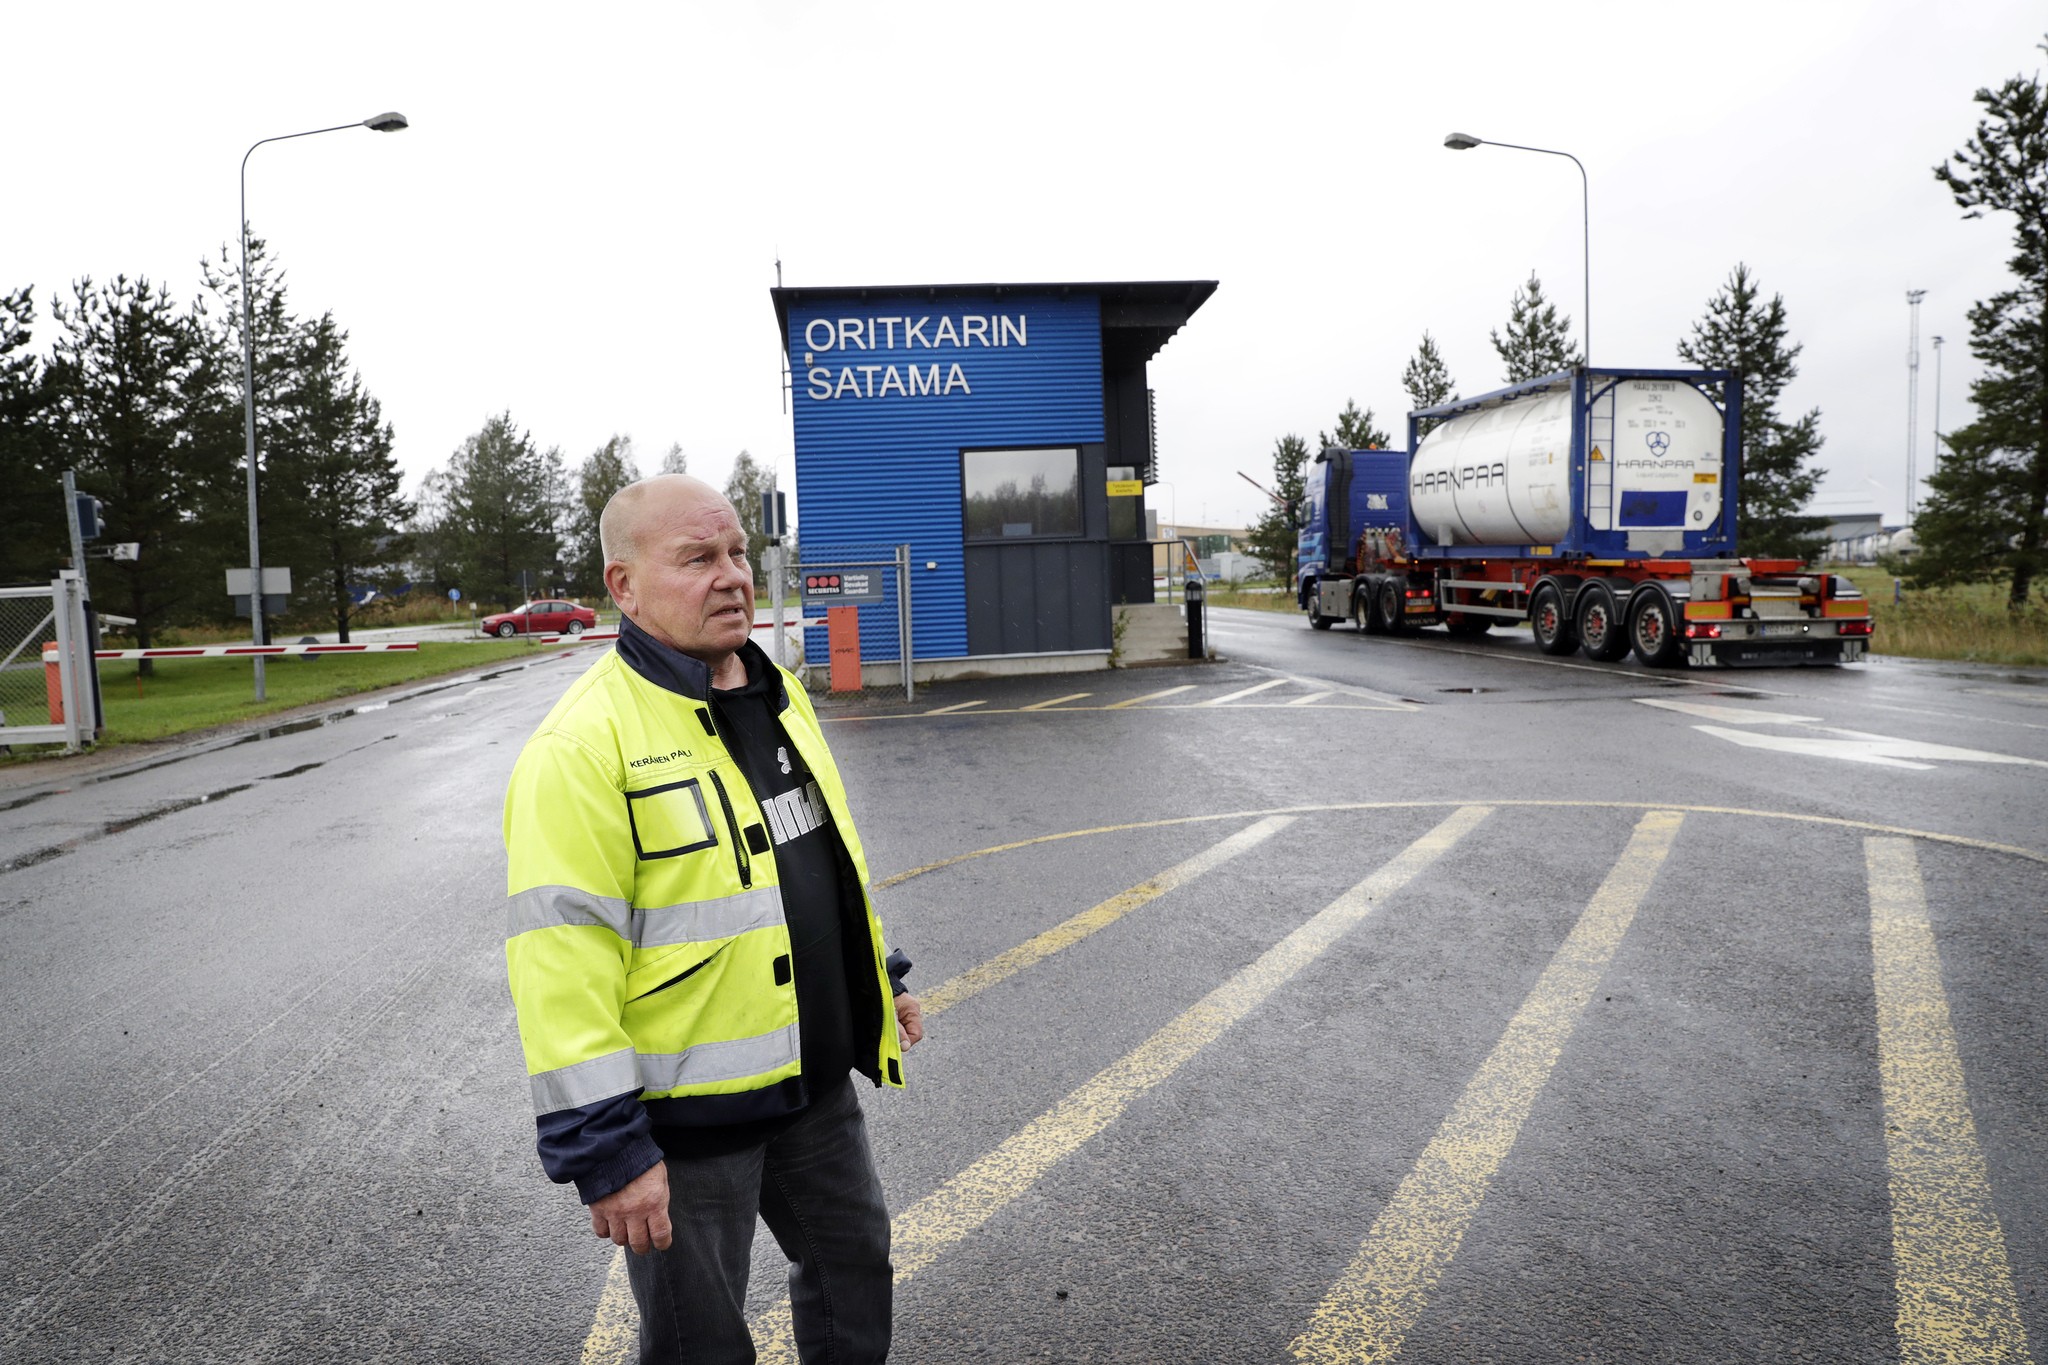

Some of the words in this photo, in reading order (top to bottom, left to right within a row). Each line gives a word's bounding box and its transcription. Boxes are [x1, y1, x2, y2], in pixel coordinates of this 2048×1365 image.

[804, 314, 1028, 352] ORITKARIN
[807, 362, 972, 400] SATAMA
[1616, 460, 1695, 469] HAANPAA
